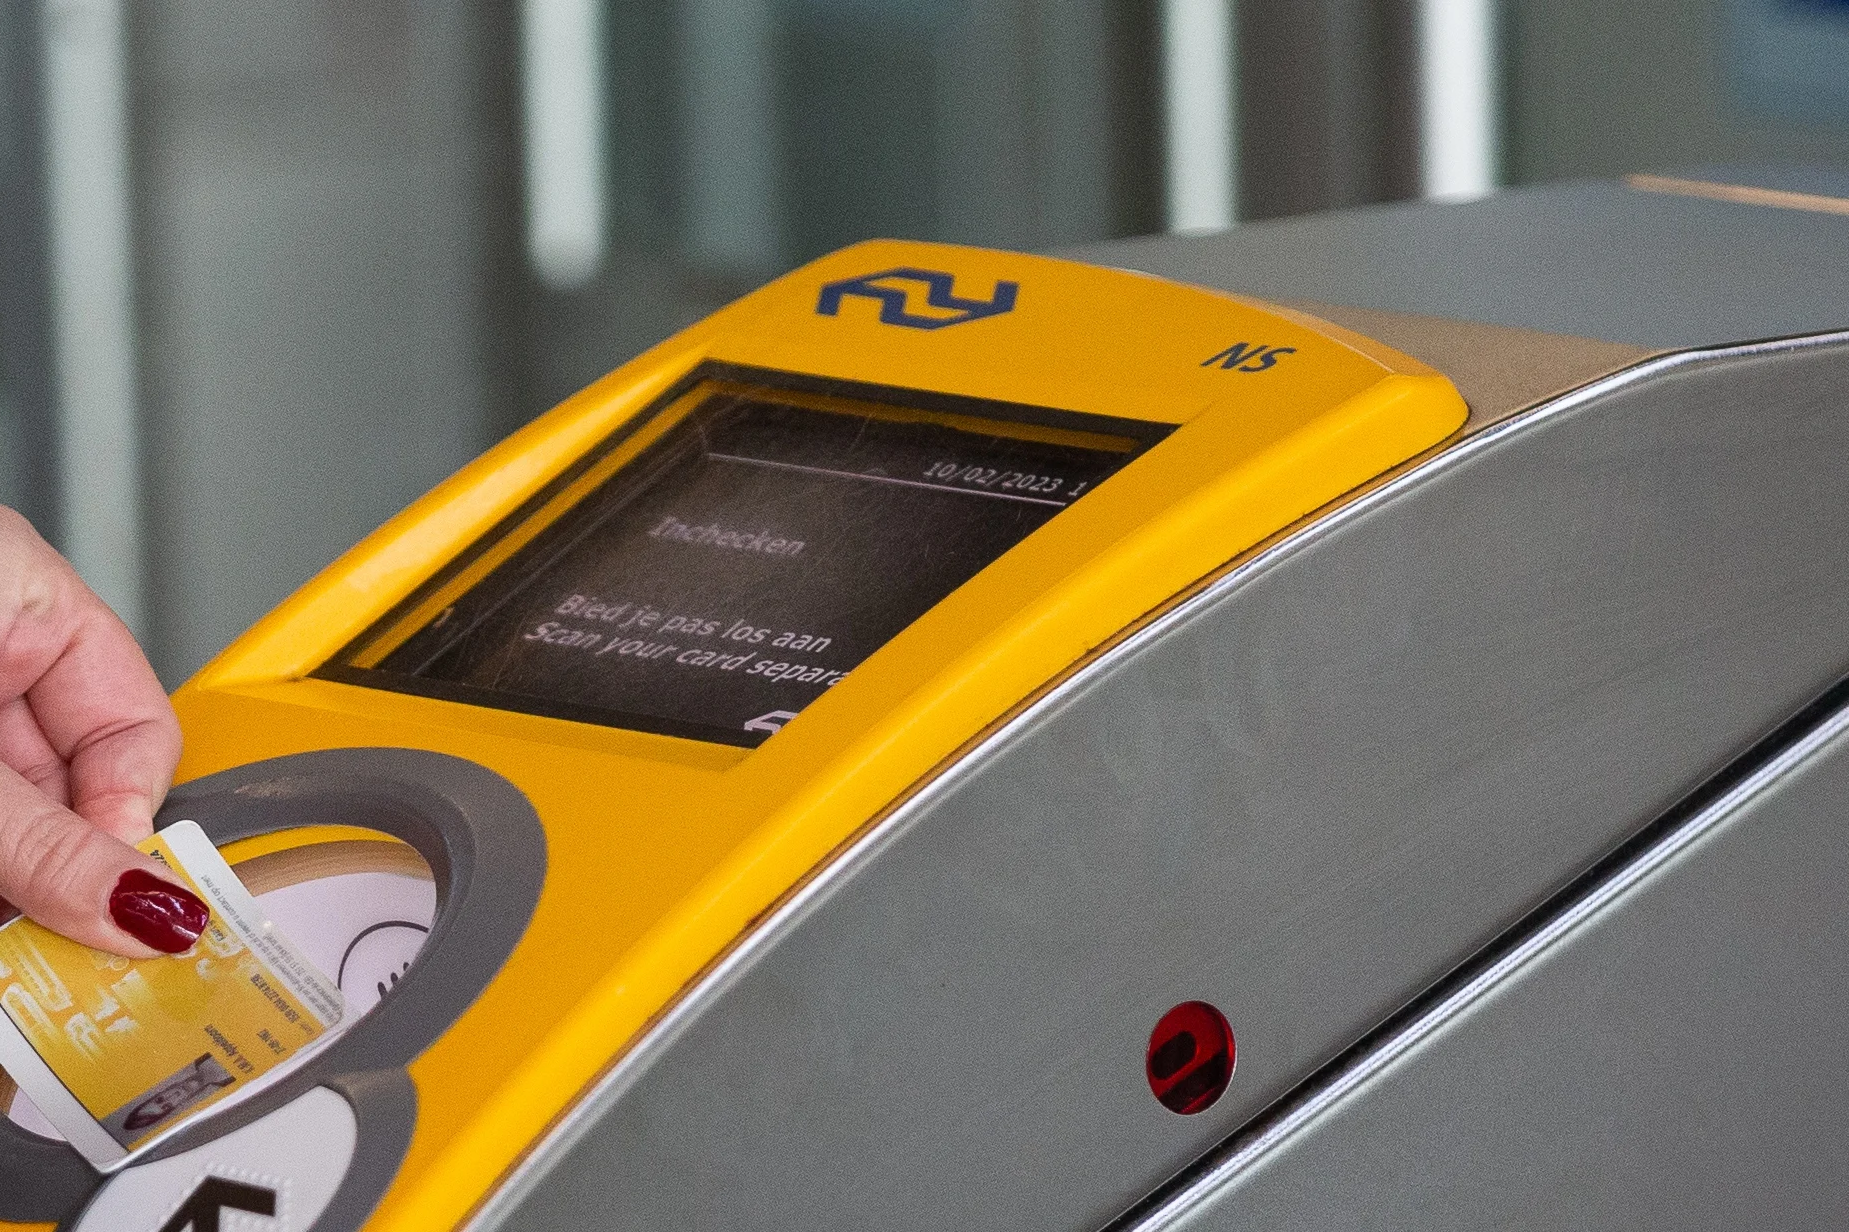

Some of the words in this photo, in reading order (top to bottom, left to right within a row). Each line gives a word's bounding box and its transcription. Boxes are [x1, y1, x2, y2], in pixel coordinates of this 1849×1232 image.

[1200, 341, 1297, 373] NS
[923, 462, 1064, 492] 10/02/2023
[649, 517, 805, 555] Inchecken
[555, 594, 628, 622] Bied
[620, 605, 660, 629] je
[657, 615, 721, 637] pas
[722, 619, 771, 646] los
[772, 632, 832, 653] aan
[524, 622, 602, 648] Scan
[596, 636, 679, 660] your
[675, 649, 756, 671] card
